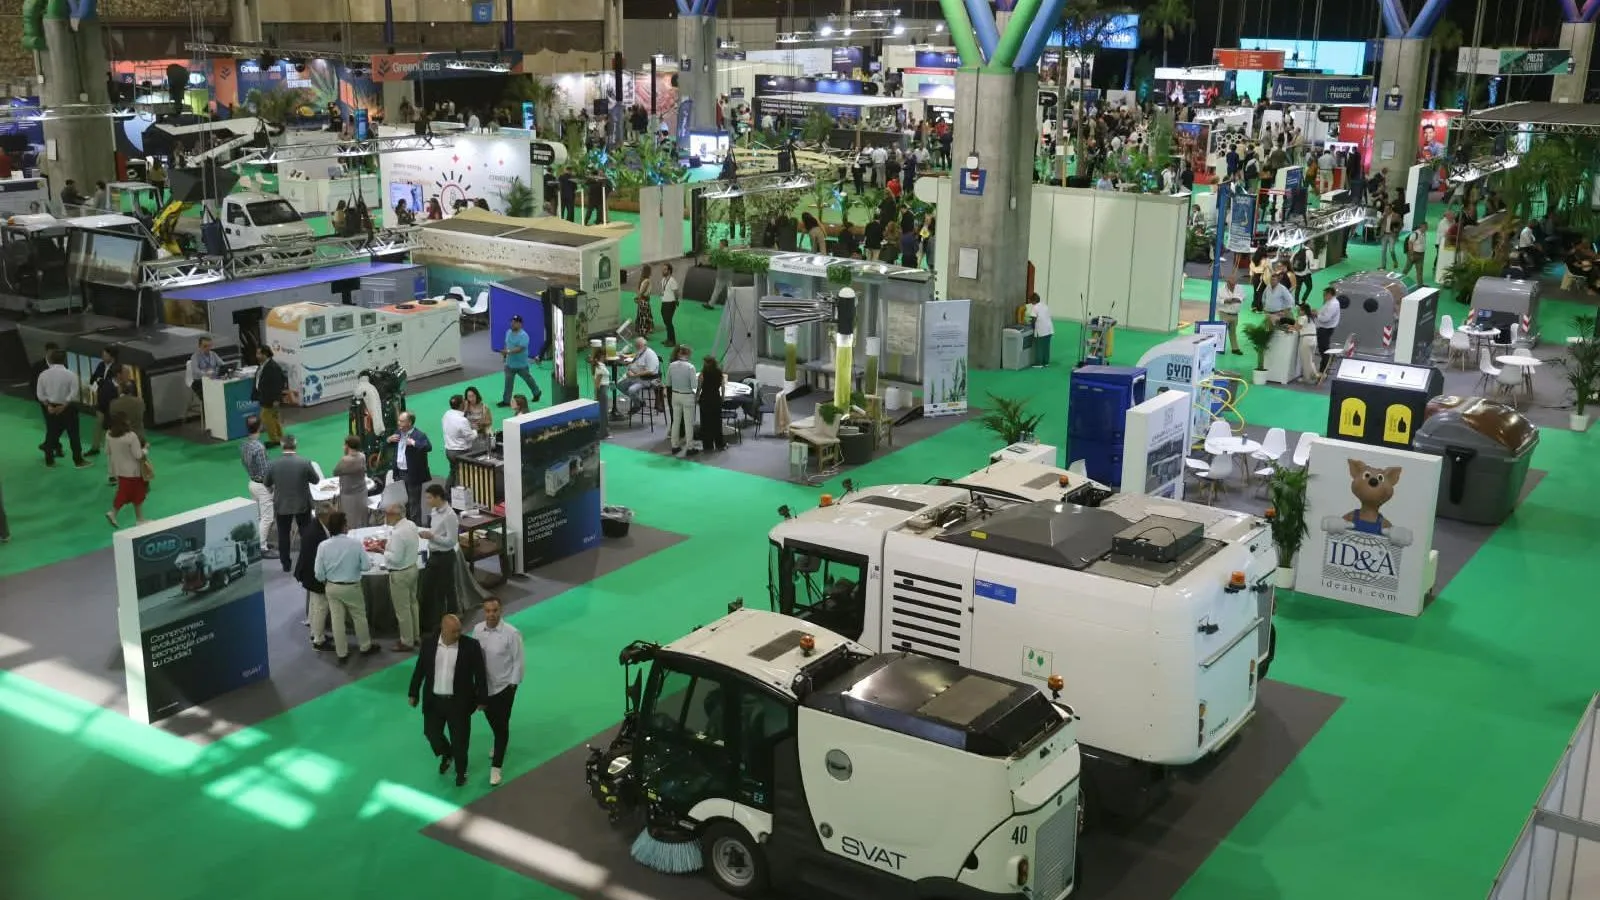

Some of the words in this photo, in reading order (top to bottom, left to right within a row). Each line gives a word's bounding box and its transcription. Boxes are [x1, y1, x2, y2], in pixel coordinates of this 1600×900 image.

[1166, 362, 1192, 379] GYM
[1329, 541, 1395, 576] ID&A
[151, 632, 192, 652] evolución
[191, 630, 198, 638] y
[151, 640, 195, 660] tecnología
[196, 631, 216, 645] para
[152, 659, 163, 668] tu
[1011, 825, 1028, 844] 40
[841, 836, 907, 870] SVAT
